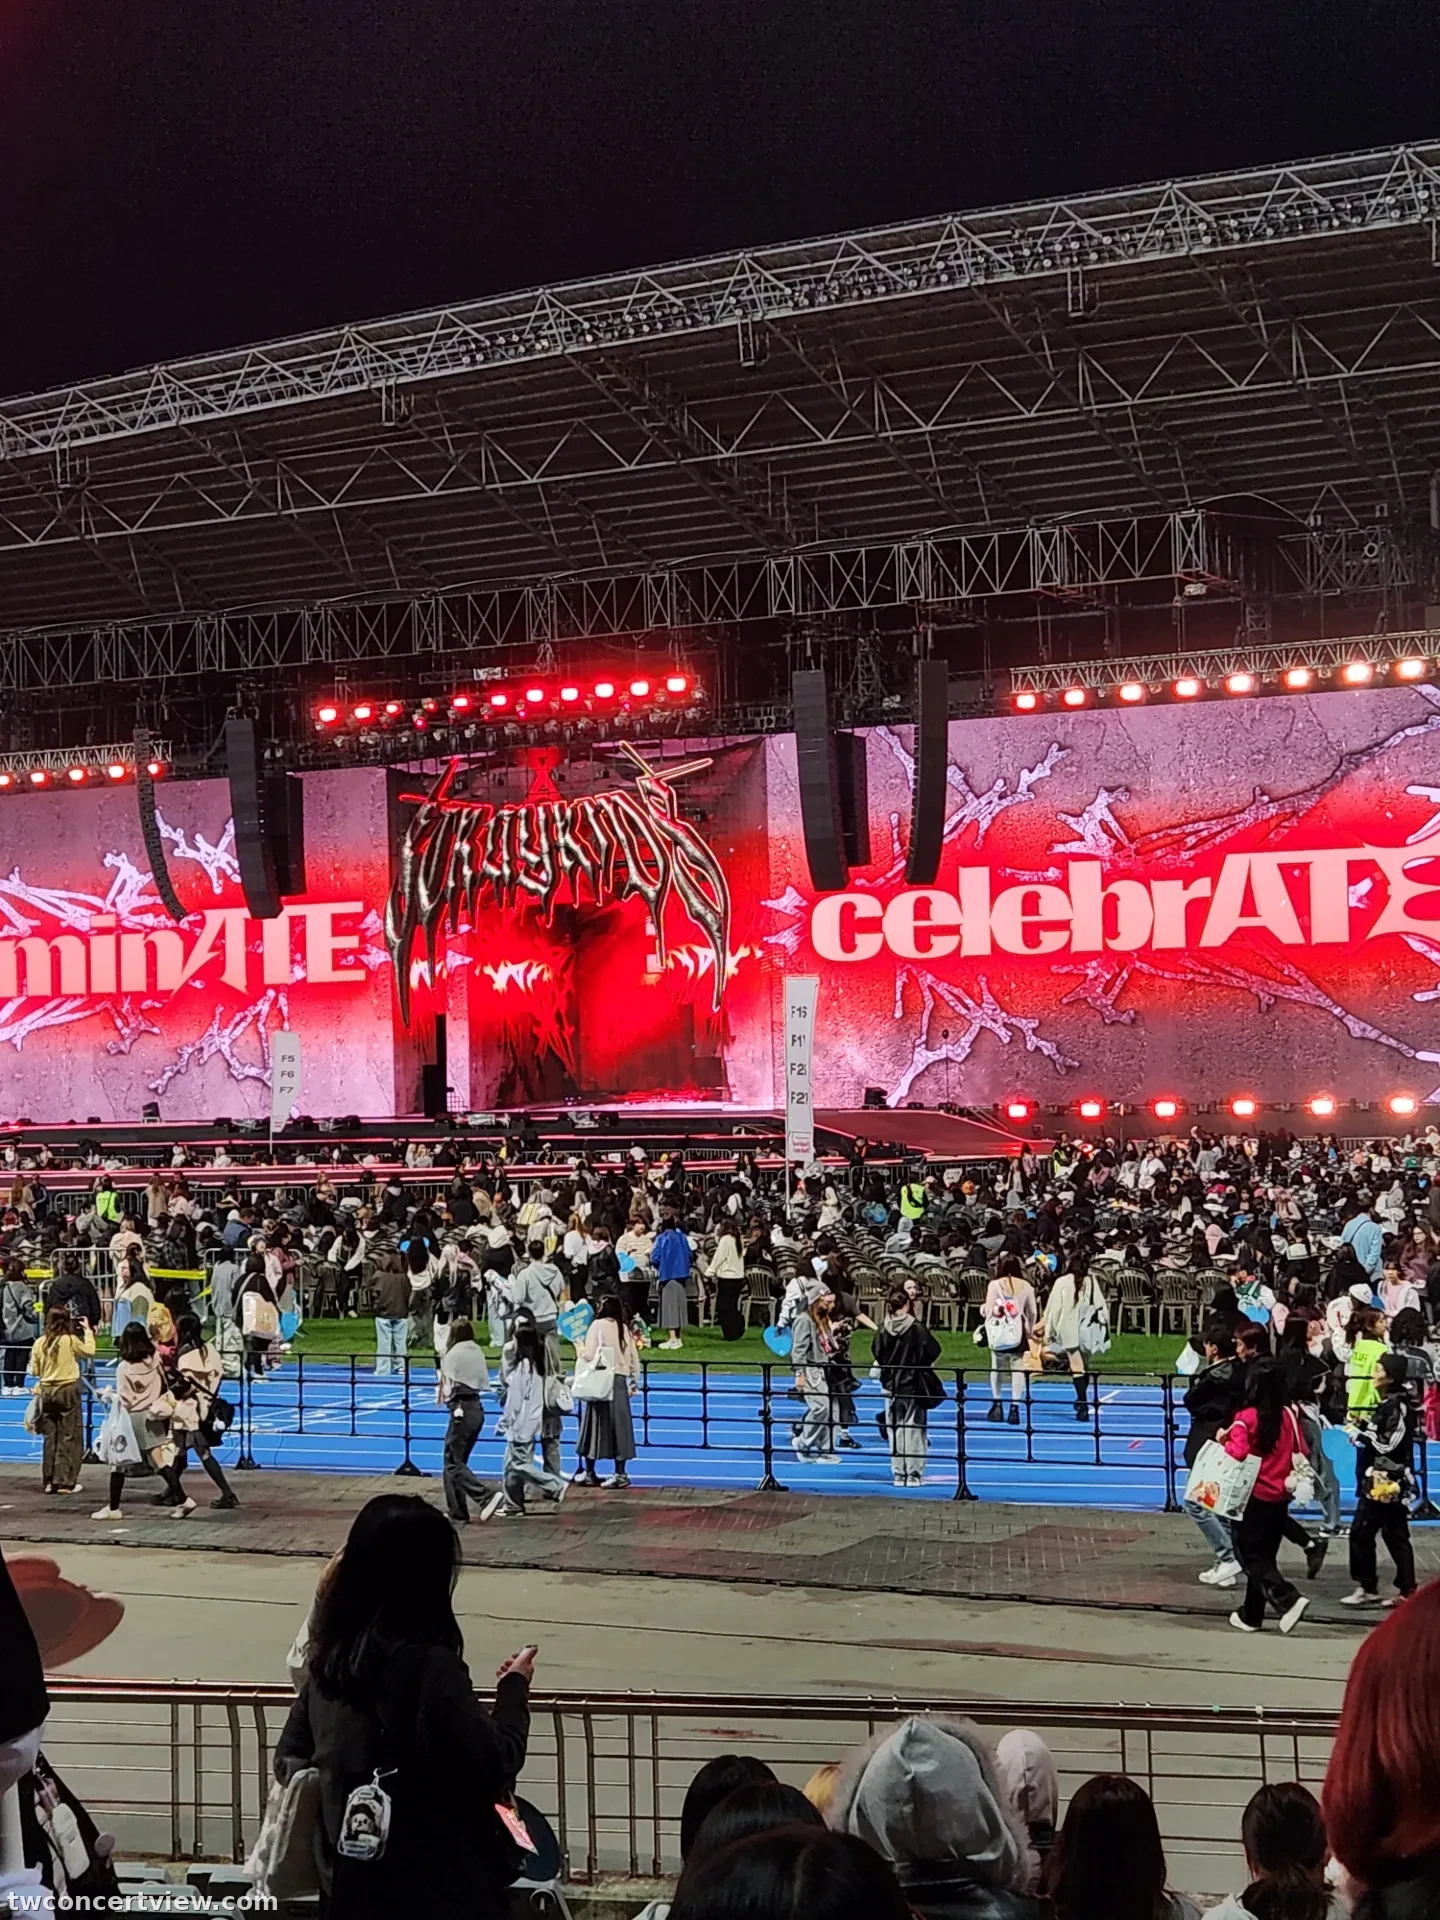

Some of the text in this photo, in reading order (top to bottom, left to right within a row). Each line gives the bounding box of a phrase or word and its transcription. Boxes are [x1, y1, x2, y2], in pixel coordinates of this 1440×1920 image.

[281, 1054, 296, 1063] F5
[280, 1070, 295, 1078] F6
[279, 1086, 294, 1094] F7
